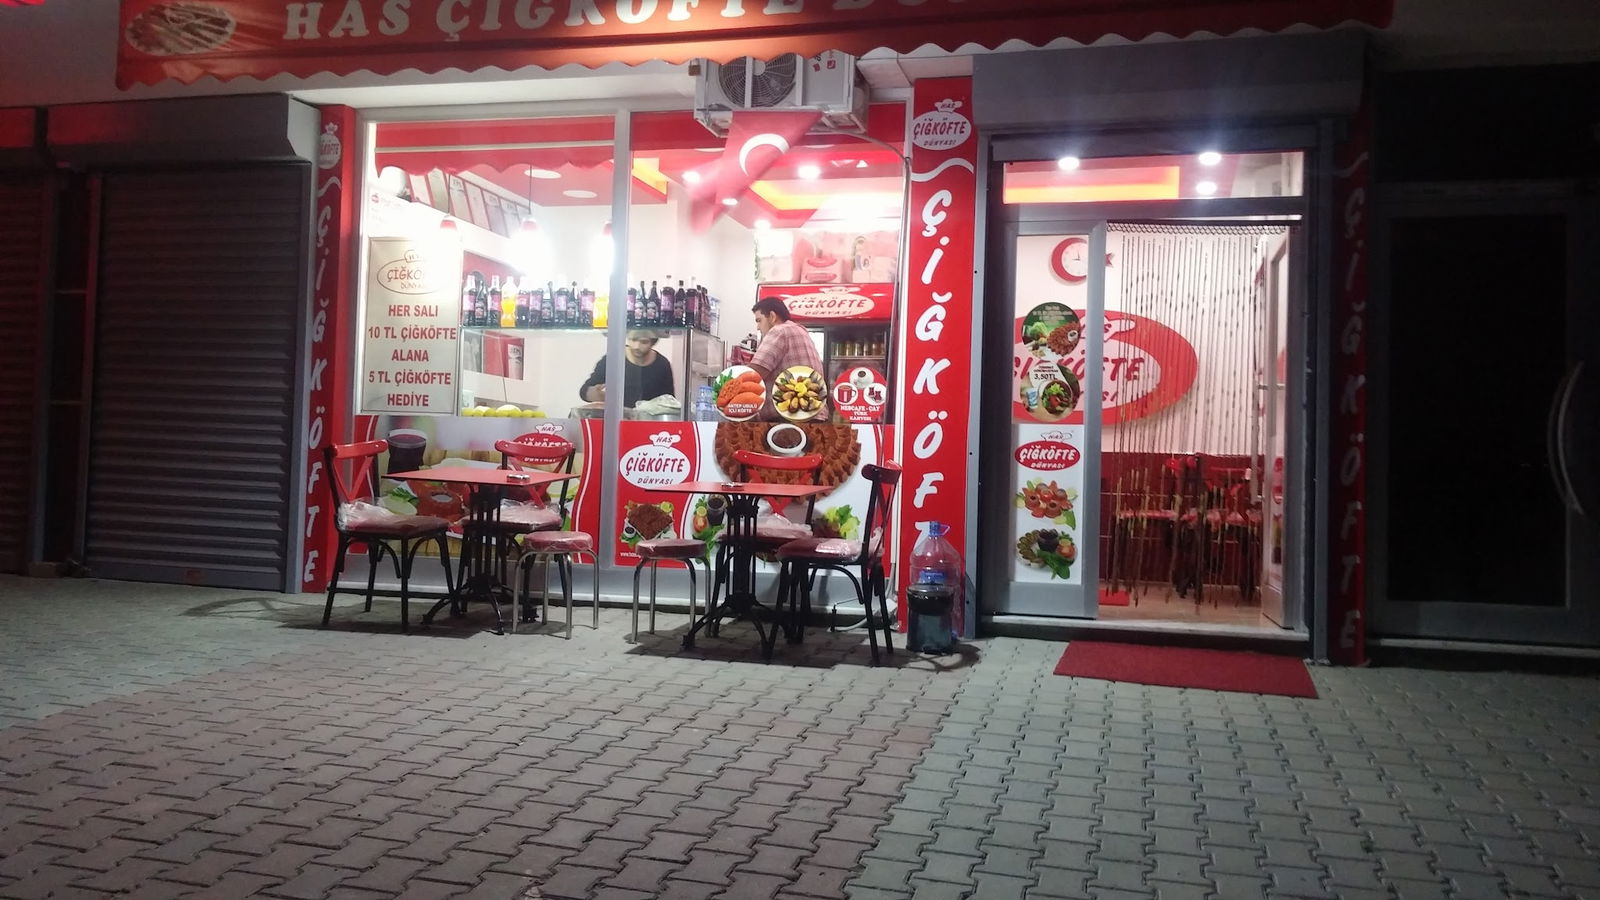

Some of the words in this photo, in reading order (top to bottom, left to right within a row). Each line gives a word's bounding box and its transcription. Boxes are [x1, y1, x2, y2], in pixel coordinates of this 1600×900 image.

[284, 2, 409, 40] HAS
[913, 117, 967, 140] ÇİĞKÖFTE
[388, 305, 410, 317] HER
[414, 305, 438, 317] SALI
[788, 296, 867, 311] ÇİĞKÖFTE
[368, 326, 380, 339] 10
[384, 327, 397, 339] TL
[401, 325, 456, 342] ÇİĞKÖFTE
[391, 349, 429, 362] ALANA
[368, 371, 375, 383] 5
[378, 371, 391, 383] TL
[395, 369, 451, 386] ÇİĞKÖFTE
[304, 205, 332, 583] ÇİĞKÖFTE
[387, 392, 429, 407] HEDİYE
[1339, 187, 1367, 649] ÇİĞKÖFTE
[1019, 445, 1077, 462] ÇİĞKÖFTE
[625, 452, 685, 476] ÇİĞKÖFTE
[1030, 461, 1065, 469] DÜNYASI
[637, 476, 674, 485] DÜNYASI
